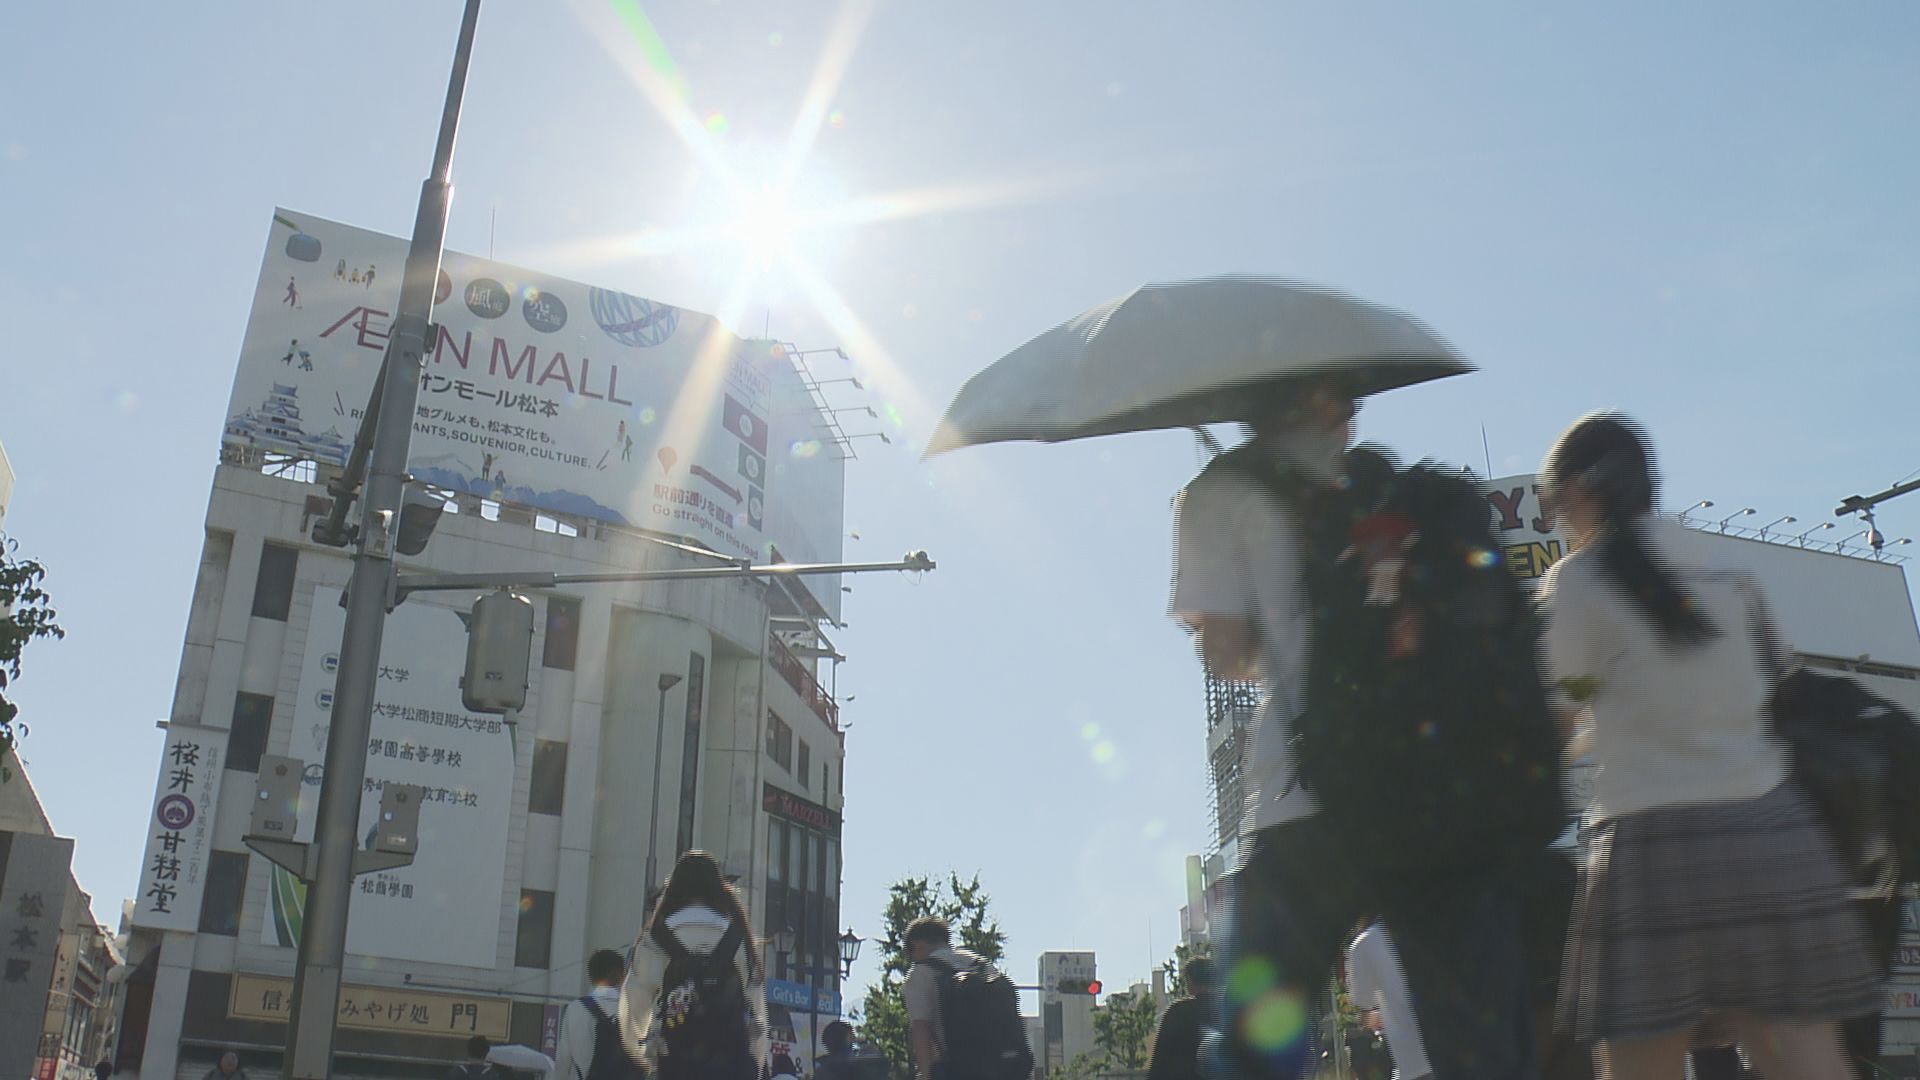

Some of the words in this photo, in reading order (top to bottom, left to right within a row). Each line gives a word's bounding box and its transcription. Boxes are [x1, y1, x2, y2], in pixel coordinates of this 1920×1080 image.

[487, 336, 634, 407] MALL
[652, 503, 671, 516] Go
[673, 508, 714, 533] straight
[714, 527, 725, 539] on
[725, 530, 741, 549] this
[741, 543, 759, 560] road
[378, 664, 410, 683] 大学
[373, 701, 503, 735] 大学松商短期大学部
[449, 1003, 478, 1031] 門
